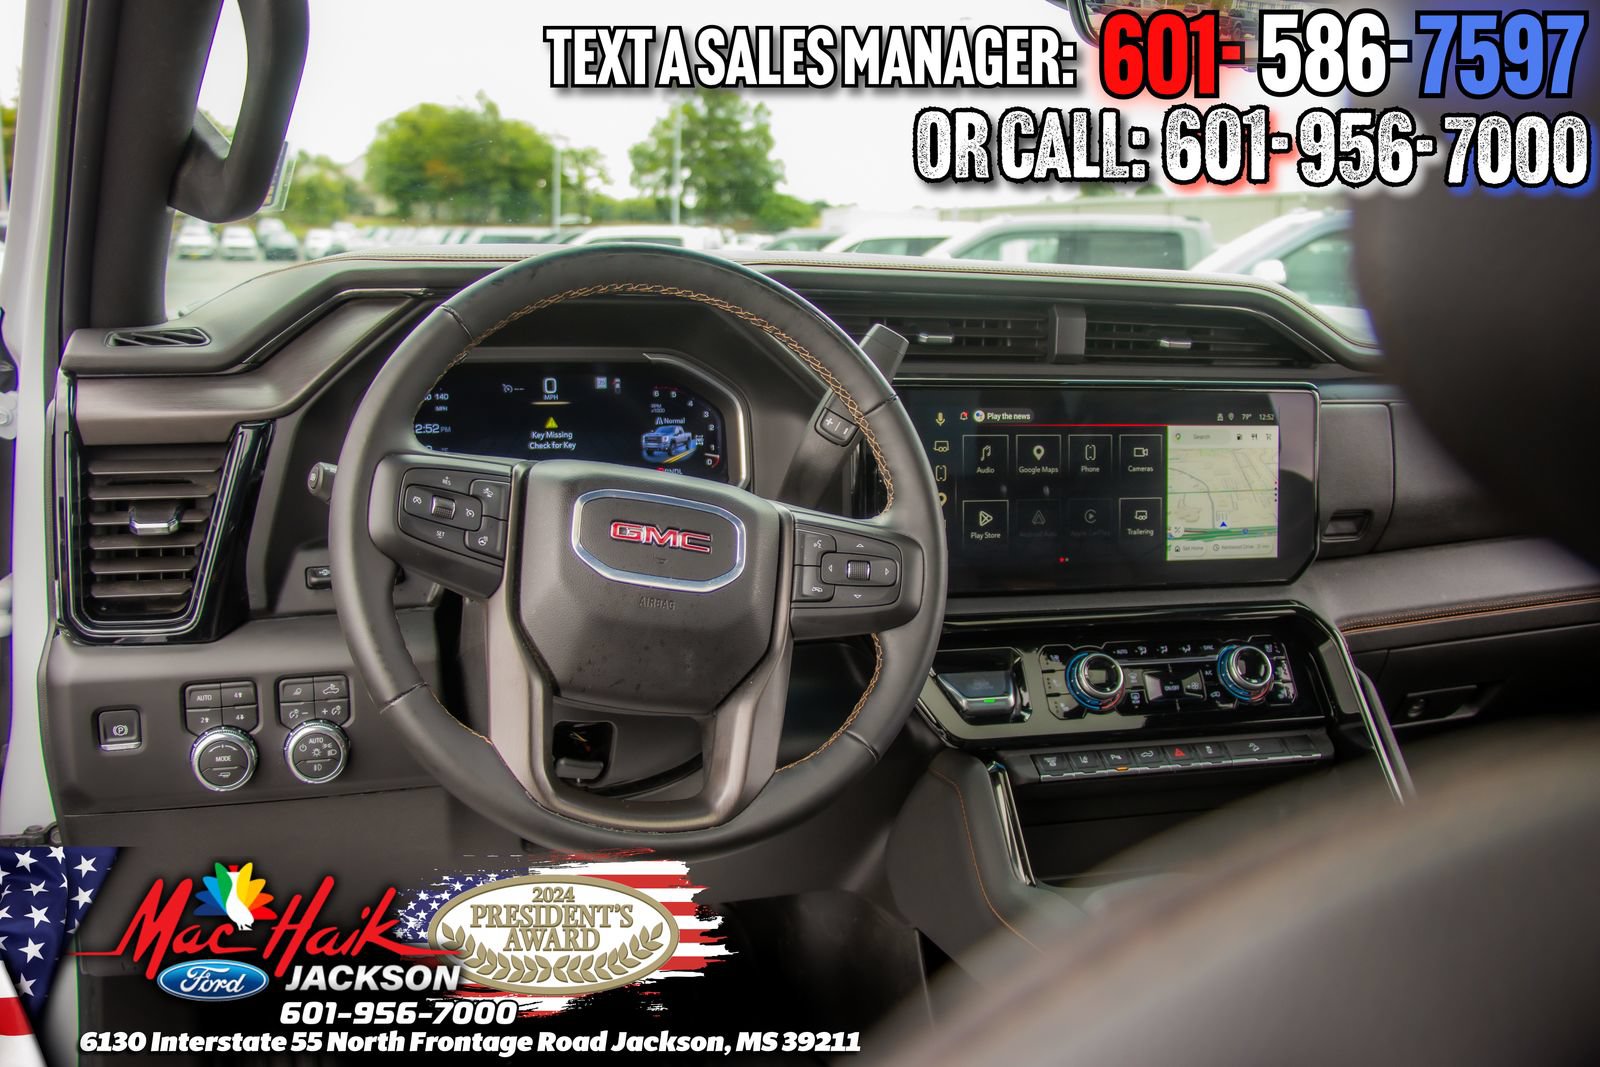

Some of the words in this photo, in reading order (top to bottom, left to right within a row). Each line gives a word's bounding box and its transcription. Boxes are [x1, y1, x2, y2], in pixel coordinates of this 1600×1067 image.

[544, 378, 557, 394] 0
[434, 393, 450, 401] 140
[986, 413, 1001, 421] Play
[1002, 412, 1012, 420] the
[532, 431, 545, 441] Key
[546, 431, 573, 440] Missing
[529, 442, 551, 450] Check
[552, 441, 562, 449] for
[563, 441, 577, 451] Key
[976, 466, 995, 474] Audio
[1018, 465, 1041, 475] Google
[1041, 466, 1059, 474] Maps
[1080, 465, 1100, 473] Phone
[1127, 465, 1154, 473] Cameras
[970, 532, 984, 540] Play
[984, 531, 1001, 539] Store
[1127, 528, 1154, 537] Trailering
[610, 520, 712, 555] GMC
[639, 596, 677, 611] AIRBAG
[196, 694, 213, 702] AUTO
[308, 737, 324, 745] AUTO
[215, 755, 232, 763] MODE
